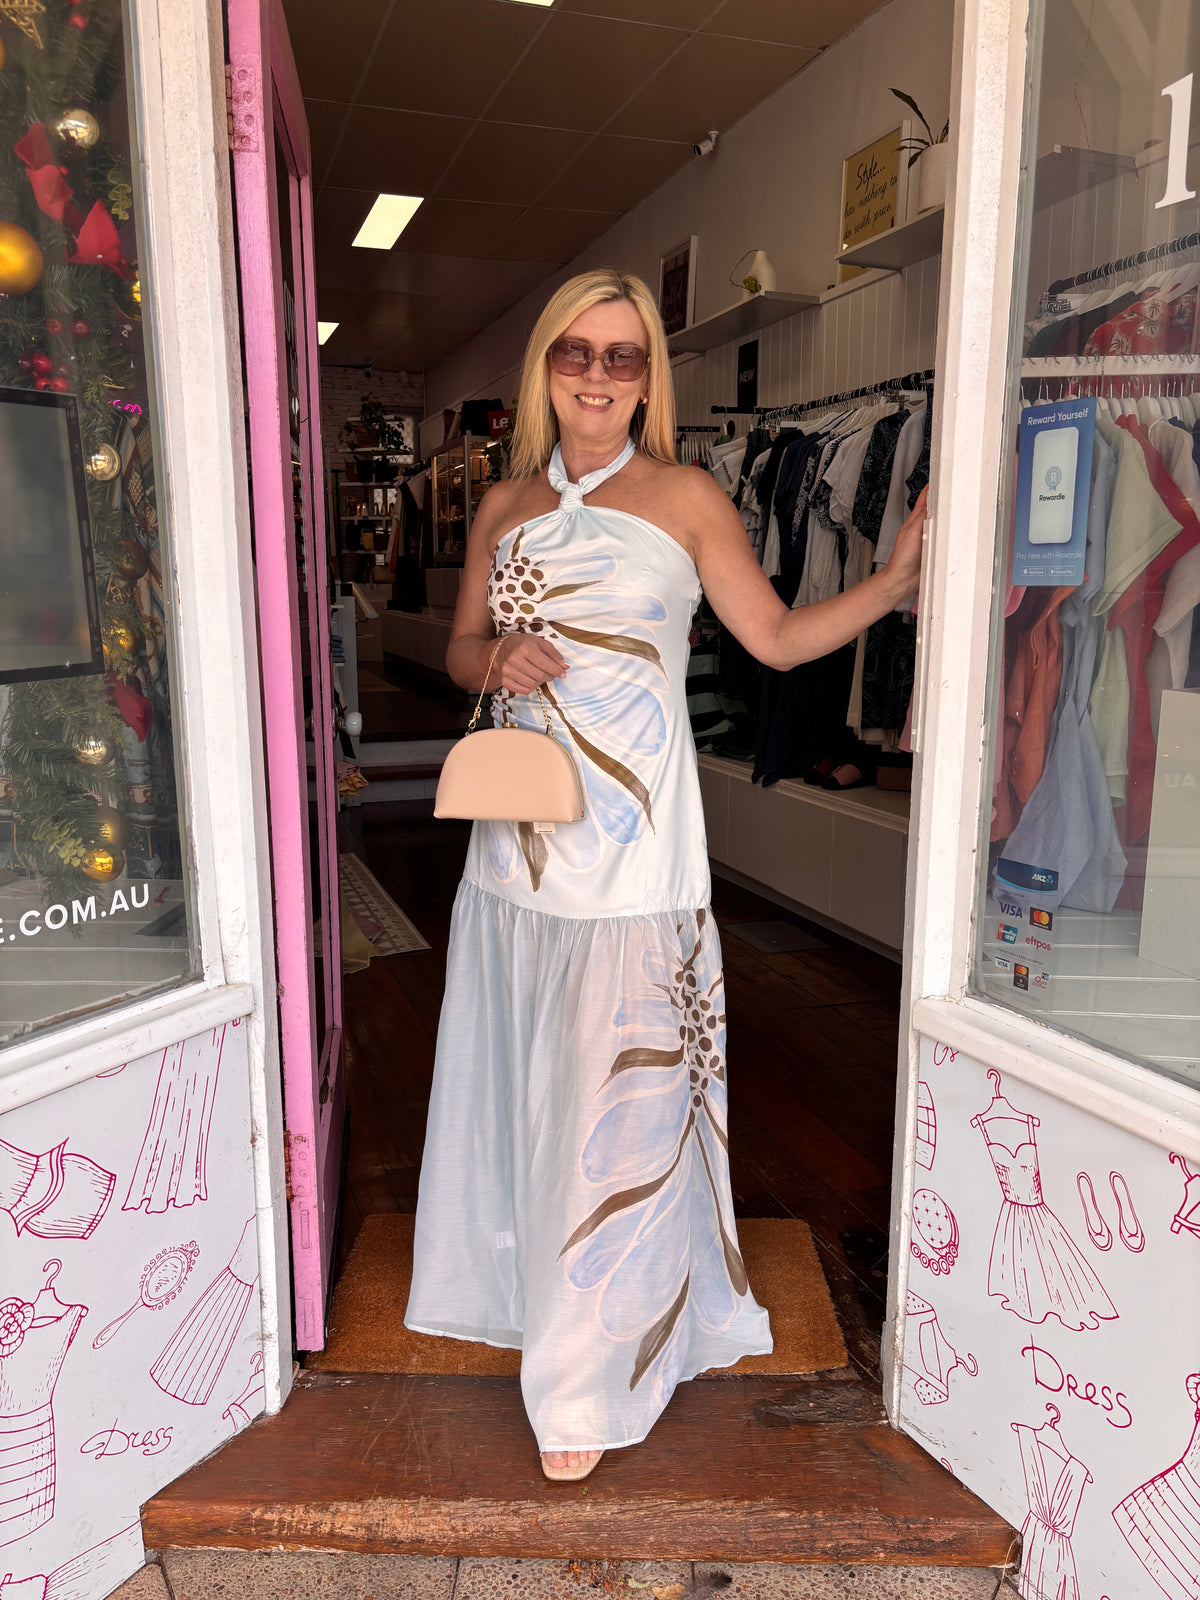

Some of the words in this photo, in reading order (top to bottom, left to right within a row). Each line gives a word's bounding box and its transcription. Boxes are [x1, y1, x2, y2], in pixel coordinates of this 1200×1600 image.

[859, 182, 887, 208] nothing
[854, 208, 871, 235] with
[739, 368, 755, 384] NEW
[1027, 413, 1056, 426] Reward
[1057, 408, 1089, 422] Yourself
[1016, 552, 1027, 560] Pay
[1028, 552, 1041, 560] here
[1041, 551, 1055, 559] with
[1032, 873, 1047, 883] ANZ
[999, 901, 1023, 919] VISA
[1025, 936, 1052, 951] eftpos
[997, 960, 1008, 968] VISA
[80, 1417, 173, 1460] Dress
